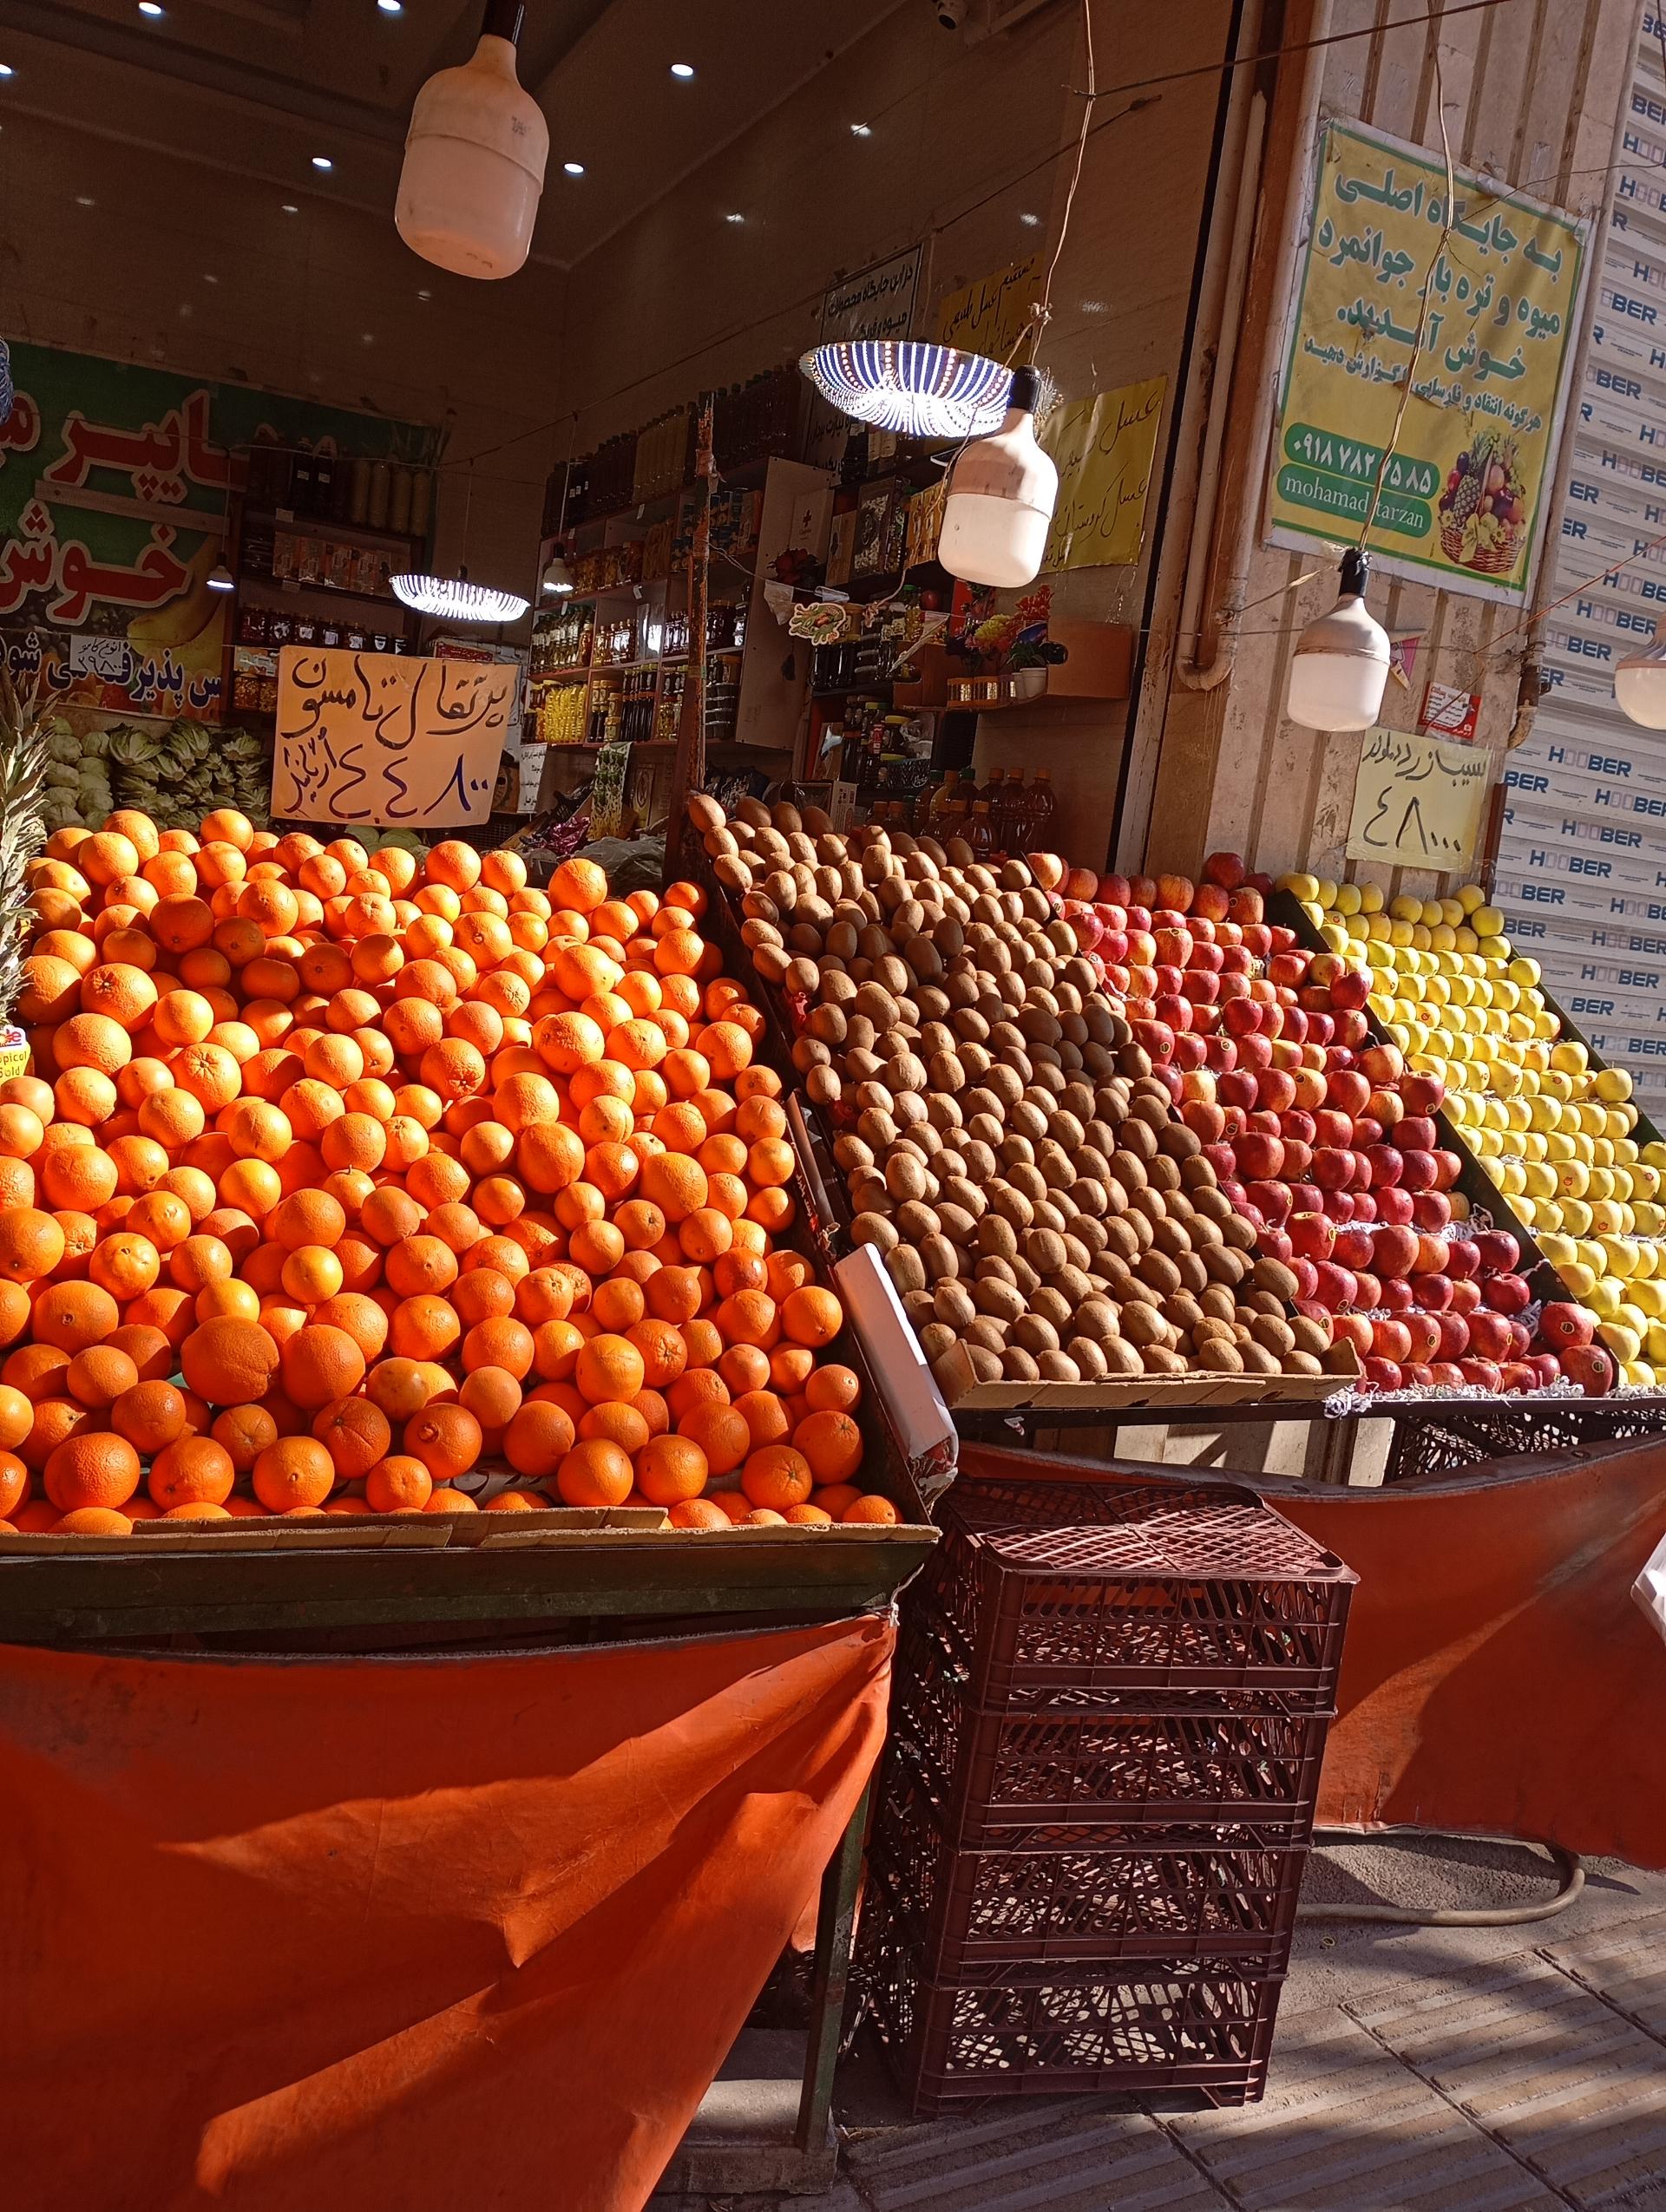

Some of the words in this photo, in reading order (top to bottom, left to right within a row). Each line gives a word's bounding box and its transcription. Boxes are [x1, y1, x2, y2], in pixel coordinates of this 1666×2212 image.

[1336, 169, 1424, 217] اصلی
[1318, 218, 1415, 287] جوانمرد
[1523, 236, 1562, 283] به
[1456, 273, 1493, 317] تره
[1492, 296, 1510, 327] و
[1518, 298, 1561, 339] میوه
[1303, 337, 1346, 365] دهید
[1444, 332, 1527, 381] خوش
[1096, 389, 1161, 455] عسل
[1099, 478, 1147, 539] عسل
[1284, 476, 1370, 514] mohamad
[1375, 501, 1425, 529] tarzan
